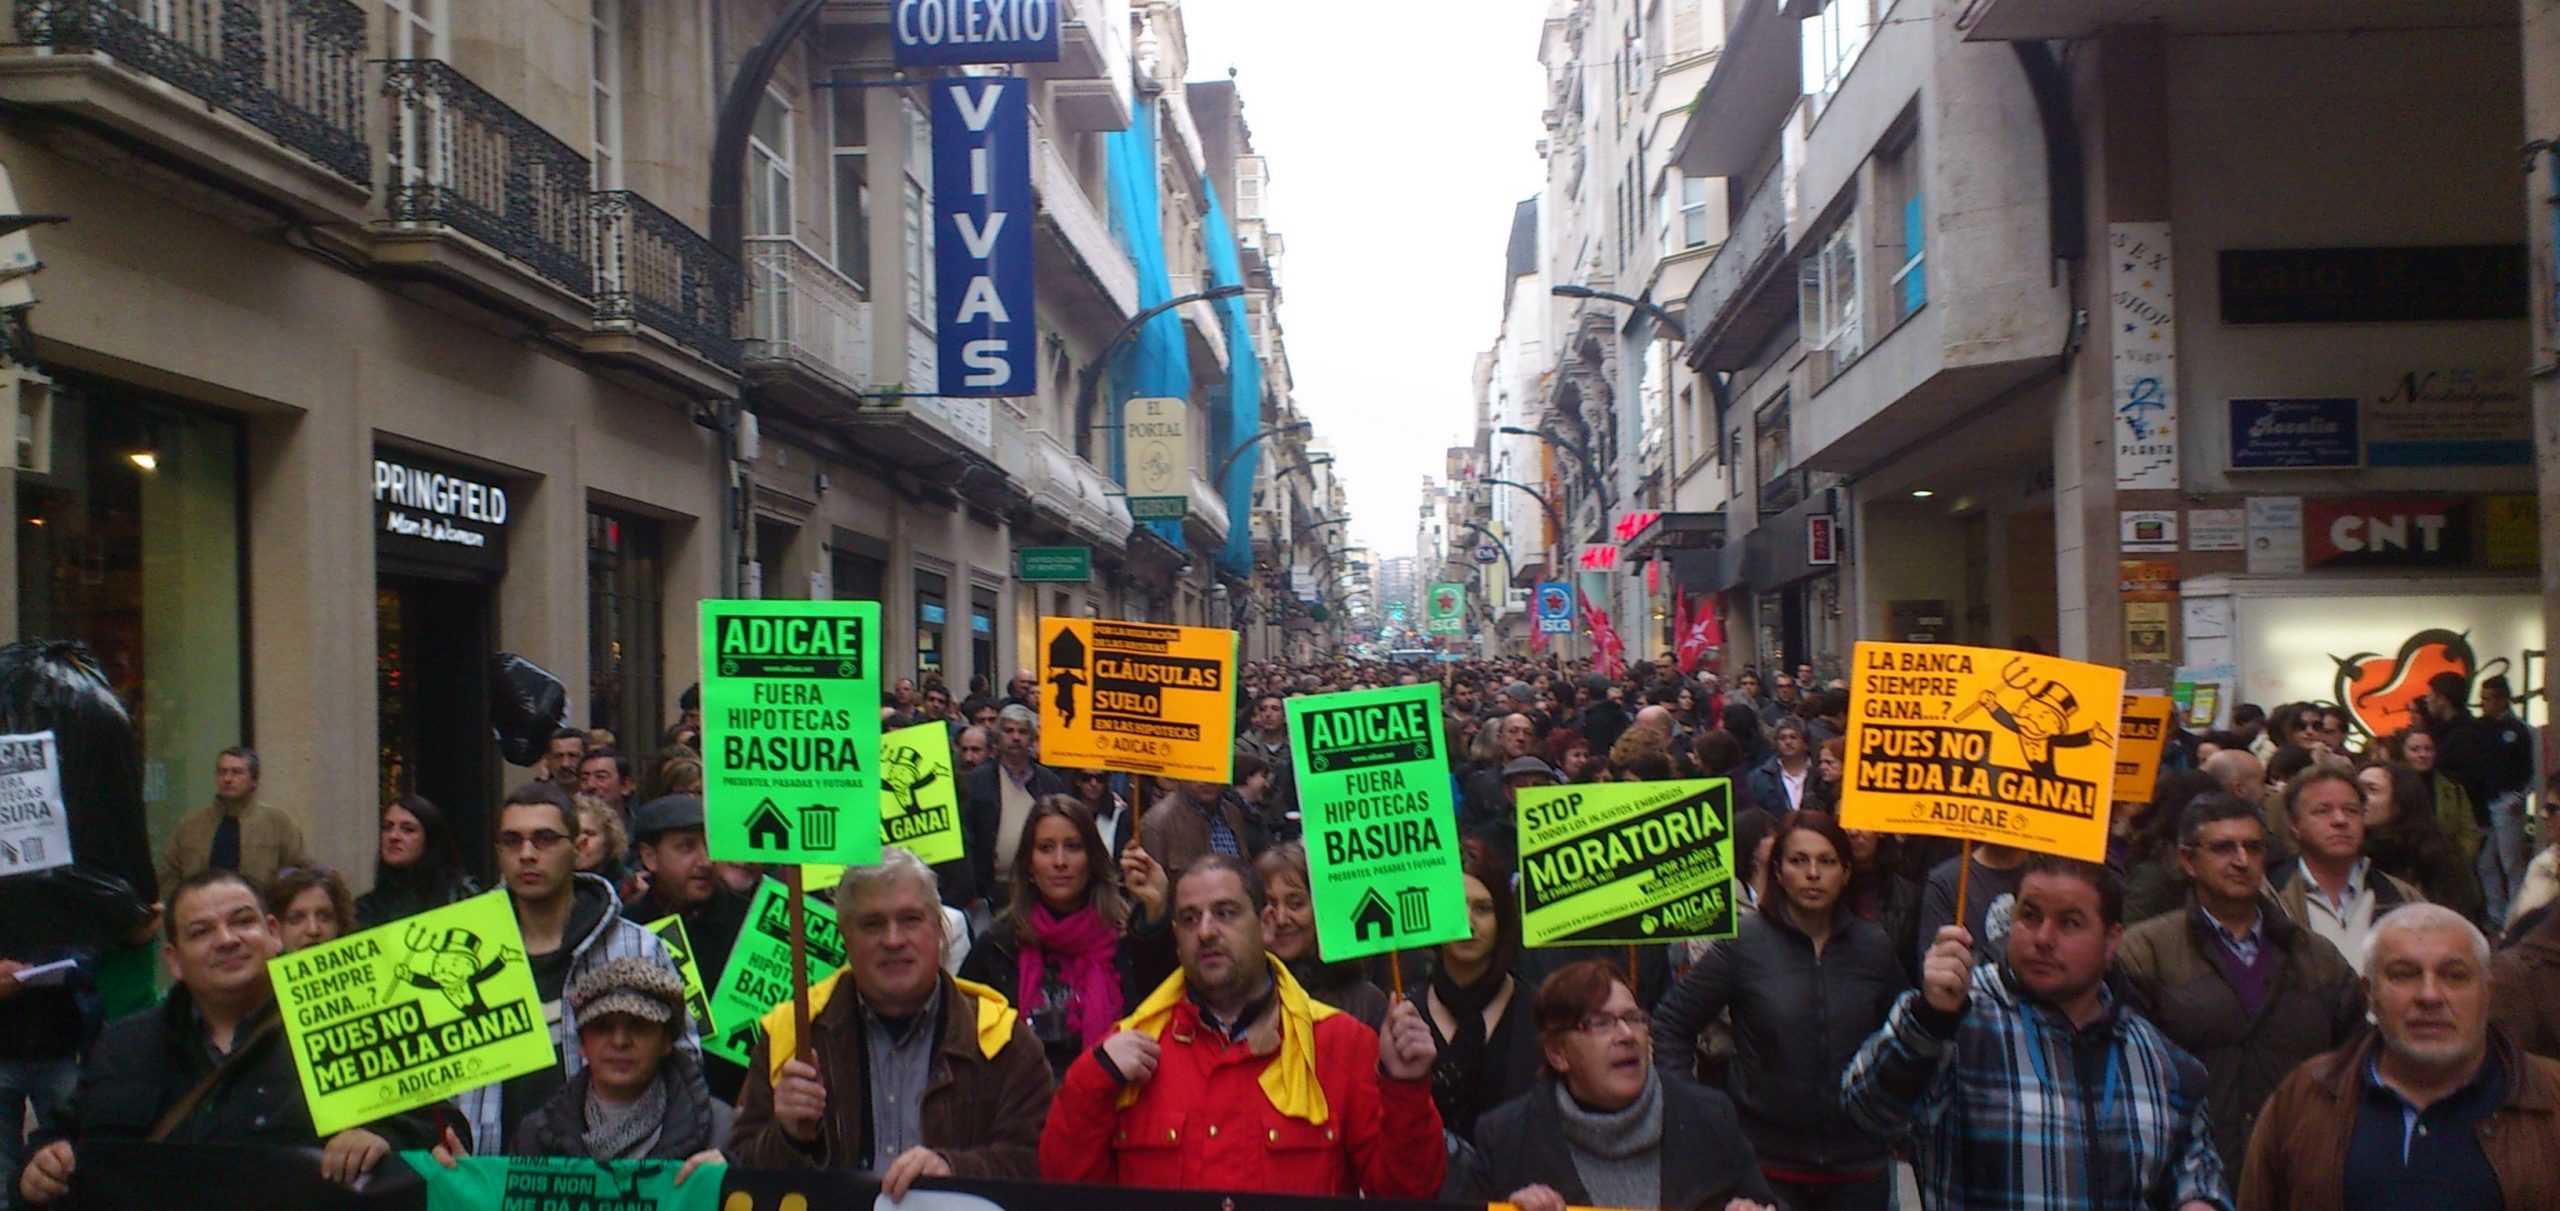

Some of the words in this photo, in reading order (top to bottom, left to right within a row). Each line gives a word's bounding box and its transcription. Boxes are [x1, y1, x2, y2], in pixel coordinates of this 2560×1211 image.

[898, 0, 1048, 45] COLEXIO
[949, 84, 1012, 387] VIVAS
[2115, 233, 2168, 269] SEX
[2115, 291, 2170, 325] SHOP
[1147, 402, 1162, 415] EL
[1128, 424, 1182, 437] PORTAL
[2121, 445, 2172, 455] PLANTA
[374, 460, 507, 525] PRINGFIELD
[2330, 514, 2447, 552] CNT
[722, 618, 857, 656] ADICAE
[1095, 657, 1219, 687] CLÁUSULAS
[1867, 651, 1894, 671] LA
[1900, 652, 1974, 675] BANCA
[753, 682, 824, 705] FUERA
[1095, 690, 1159, 714] SUELO
[1866, 675, 1958, 697] SIEMPRE
[728, 708, 851, 731] HIPOTECAS
[1095, 718, 1112, 729] EN
[1115, 719, 1135, 732] LAS
[1136, 722, 1198, 740] HIPOTECAS
[1312, 703, 1426, 749] ADICAE
[724, 735, 861, 772] BASURA
[1113, 737, 1157, 755] ADICAE
[1862, 727, 1938, 760] PUES
[1940, 731, 1986, 762] NO
[1346, 769, 1406, 795] FUERA
[1859, 761, 1906, 790] ME
[1906, 763, 1946, 793] DA
[1949, 766, 1993, 798] LA
[1996, 778, 2095, 817] GANA!
[891, 807, 948, 840] GANA!
[1325, 791, 1430, 825] HIPOTECAS
[1524, 792, 1584, 831] STOP
[1537, 824, 1569, 842] TODOS
[1570, 818, 1588, 832] LOS
[1590, 803, 1634, 825] INJUSTOS
[1635, 786, 1684, 811] EMBARGOS
[1930, 801, 2009, 829] ADICAE
[1324, 817, 1442, 866] BASURA
[1526, 800, 1726, 893] MORATORIA
[1657, 861, 1678, 878] POR
[1688, 846, 1716, 867] AÑOS
[764, 892, 846, 951] ACAE
[1662, 887, 1726, 930] ADICAE
[283, 961, 312, 983] LA
[316, 938, 382, 967] BANCA
[291, 964, 376, 1005] SIEMPRE
[297, 986, 378, 1027] GANA...?
[306, 1018, 377, 1062] PUES
[380, 1004, 420, 1038] NO
[314, 1056, 360, 1093] ME
[359, 1048, 399, 1079] DA
[399, 1032, 440, 1066] LA
[441, 1002, 531, 1051] GANA!
[397, 1060, 467, 1096] ADICAE
[508, 1174, 548, 1191] POIS
[553, 1177, 593, 1194] NON
[502, 1196, 531, 1211] ME
